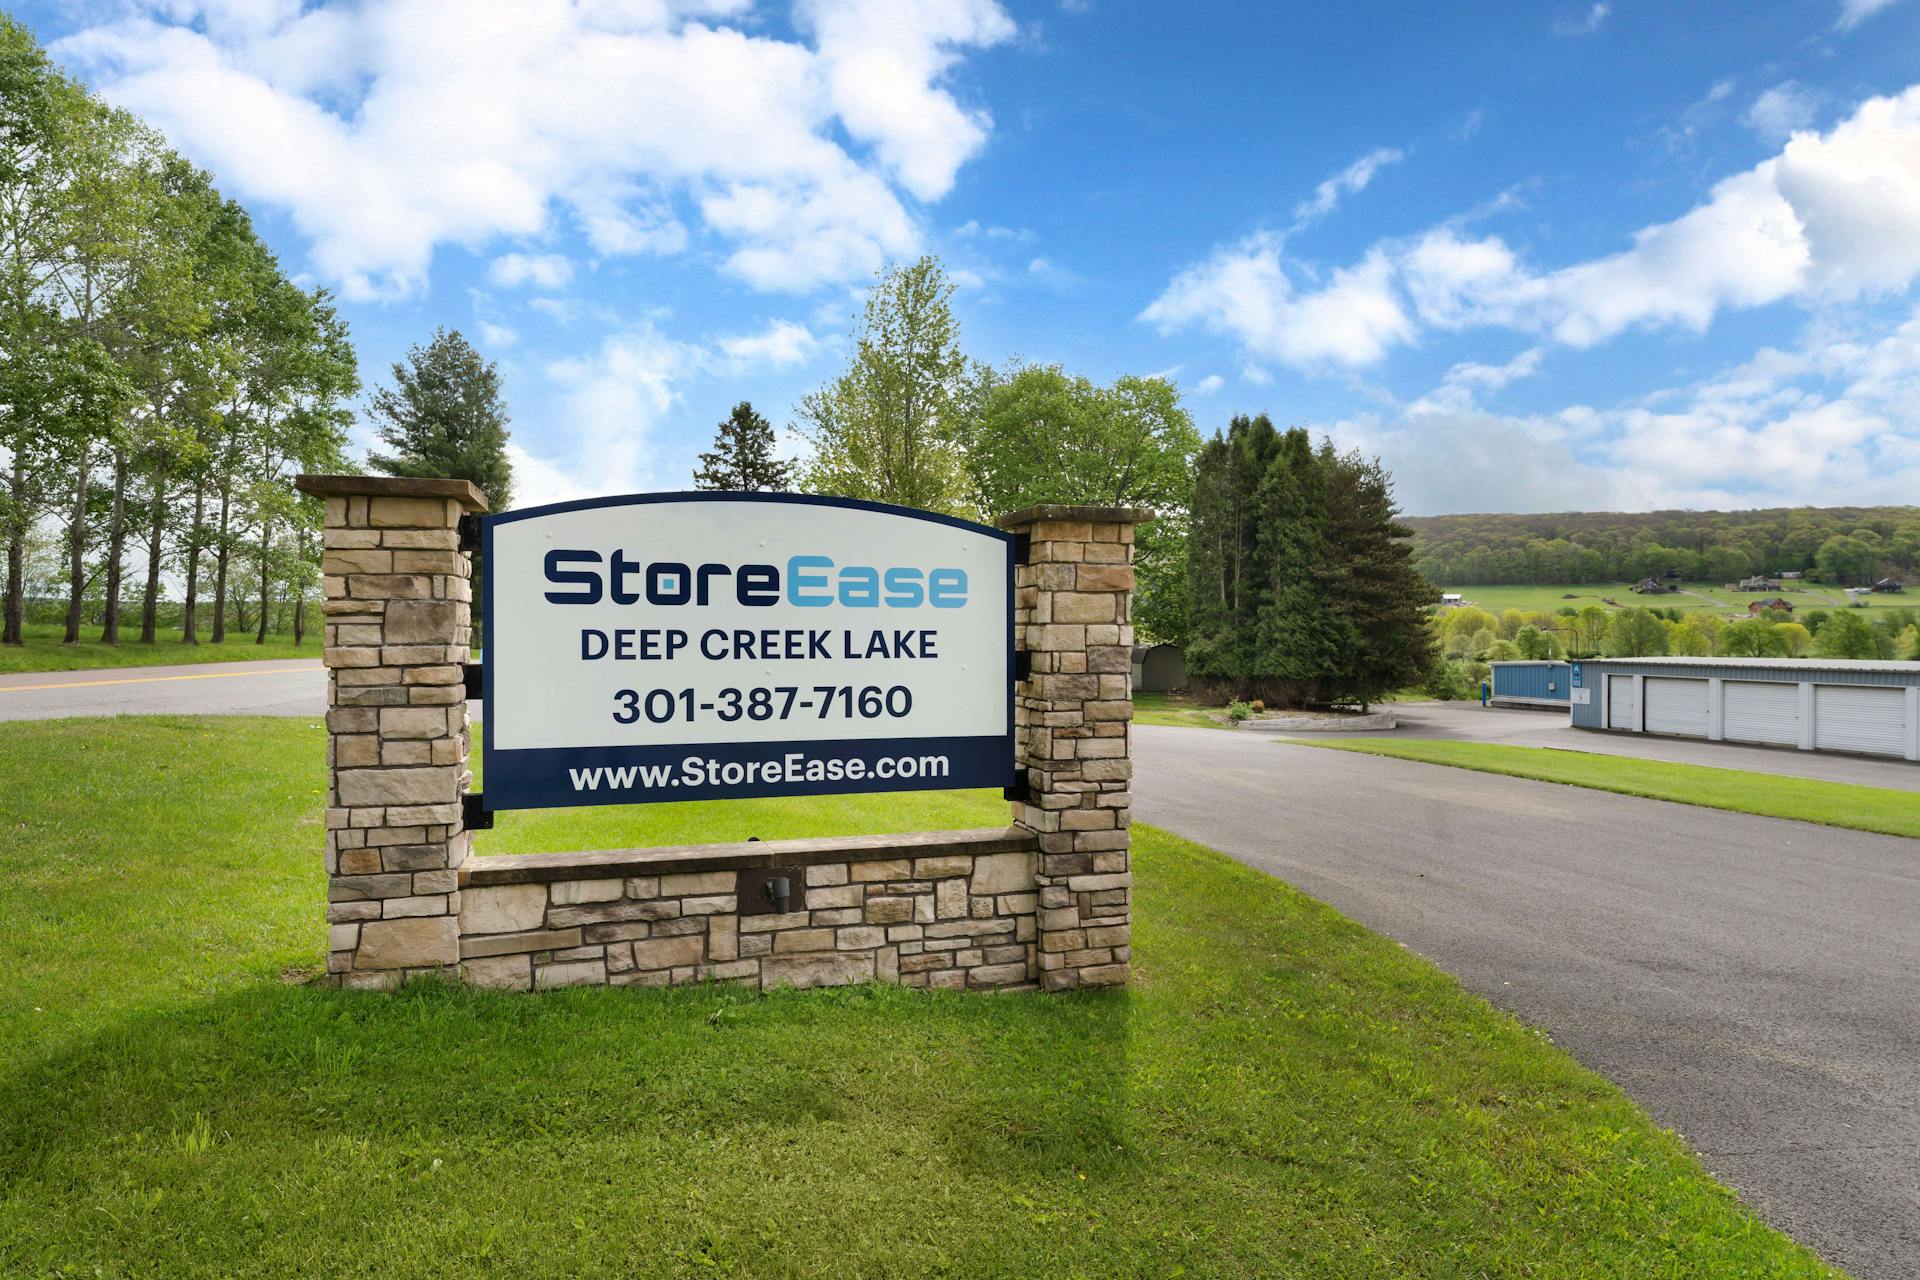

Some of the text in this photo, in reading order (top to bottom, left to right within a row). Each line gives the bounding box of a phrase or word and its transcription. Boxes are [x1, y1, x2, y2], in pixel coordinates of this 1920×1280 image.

[544, 549, 967, 608] StoreEase
[581, 629, 938, 660] DEEP CREEK LAKE
[612, 686, 912, 724] 301-387-7160
[569, 753, 949, 791] www.StoreEase.com
